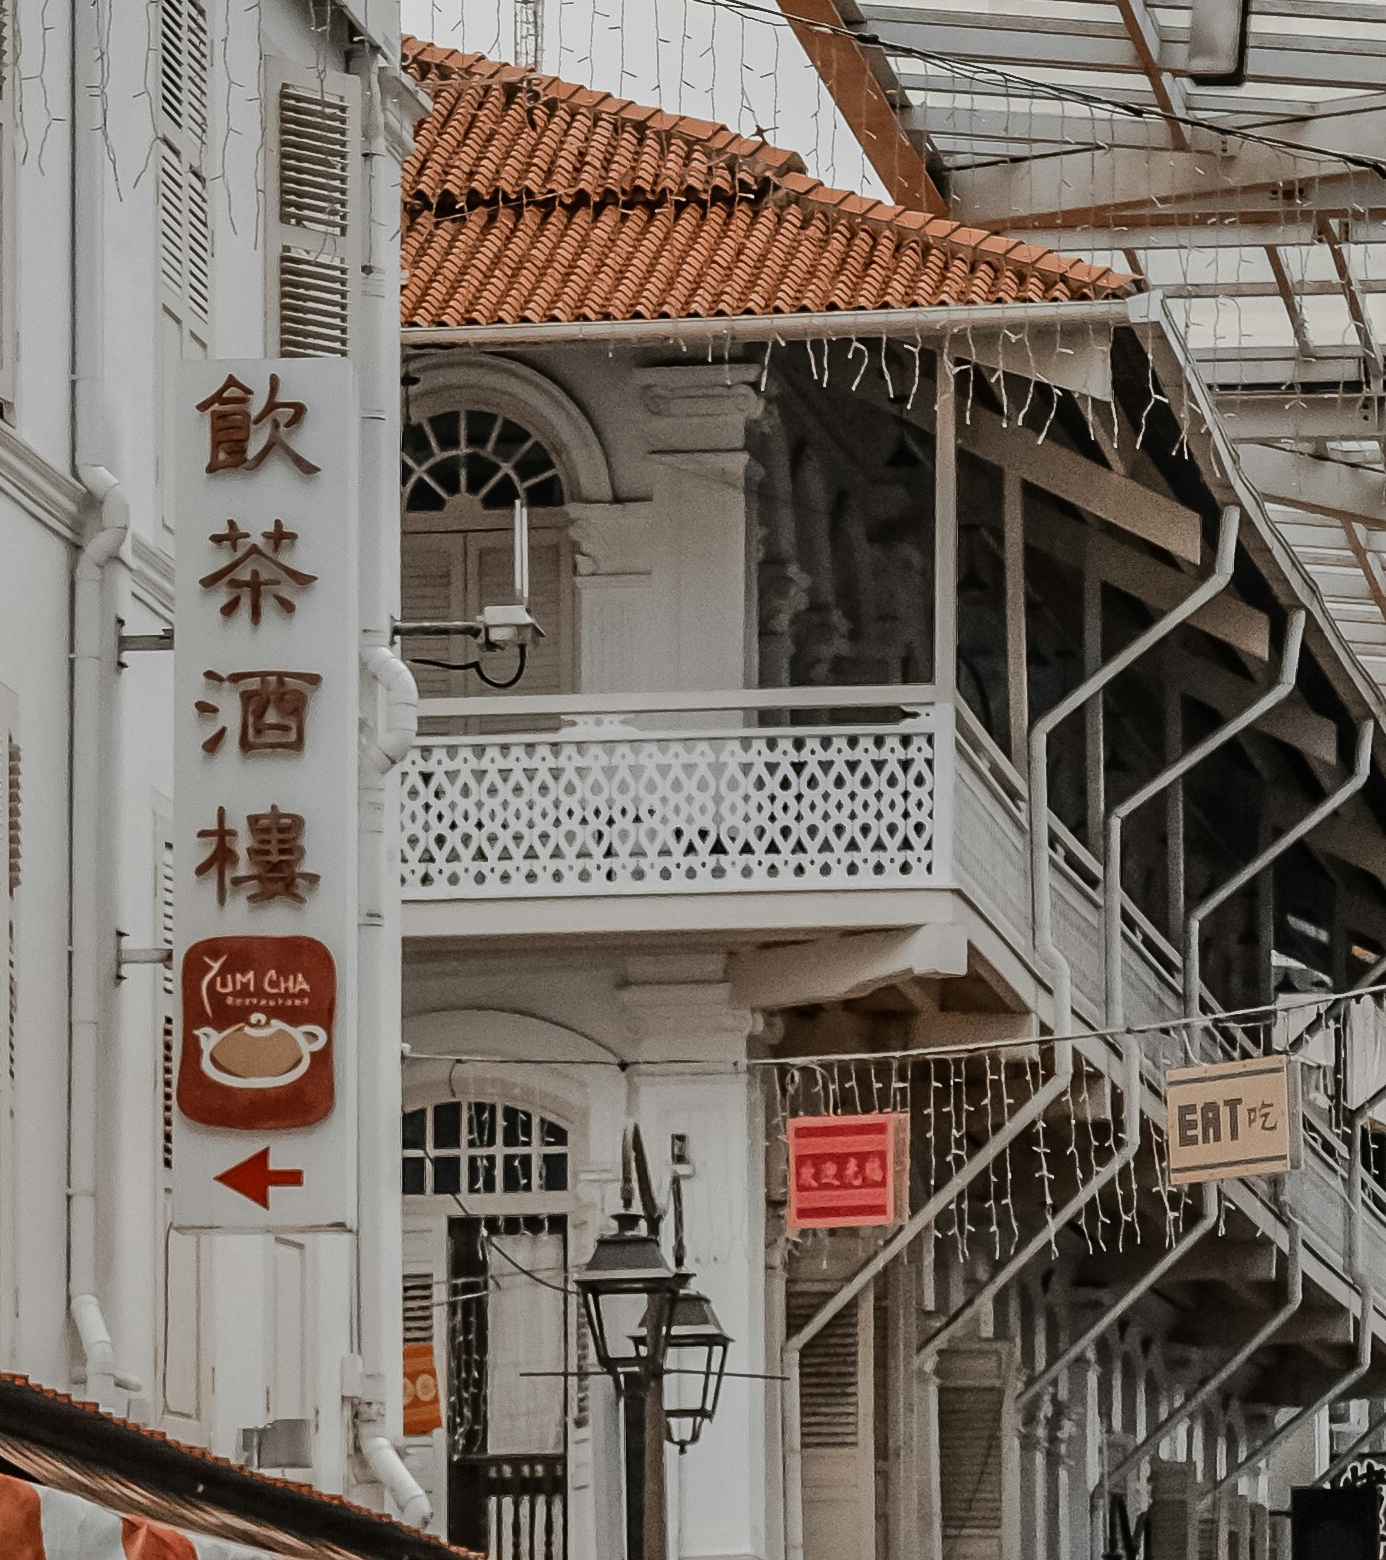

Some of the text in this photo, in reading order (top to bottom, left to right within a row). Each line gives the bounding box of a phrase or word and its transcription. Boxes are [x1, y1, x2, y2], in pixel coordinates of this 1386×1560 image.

[193, 372, 323, 908] 飲茶酒樓
[203, 953, 311, 1019] YUM CHA
[1177, 1097, 1278, 1148] EAT 吃
